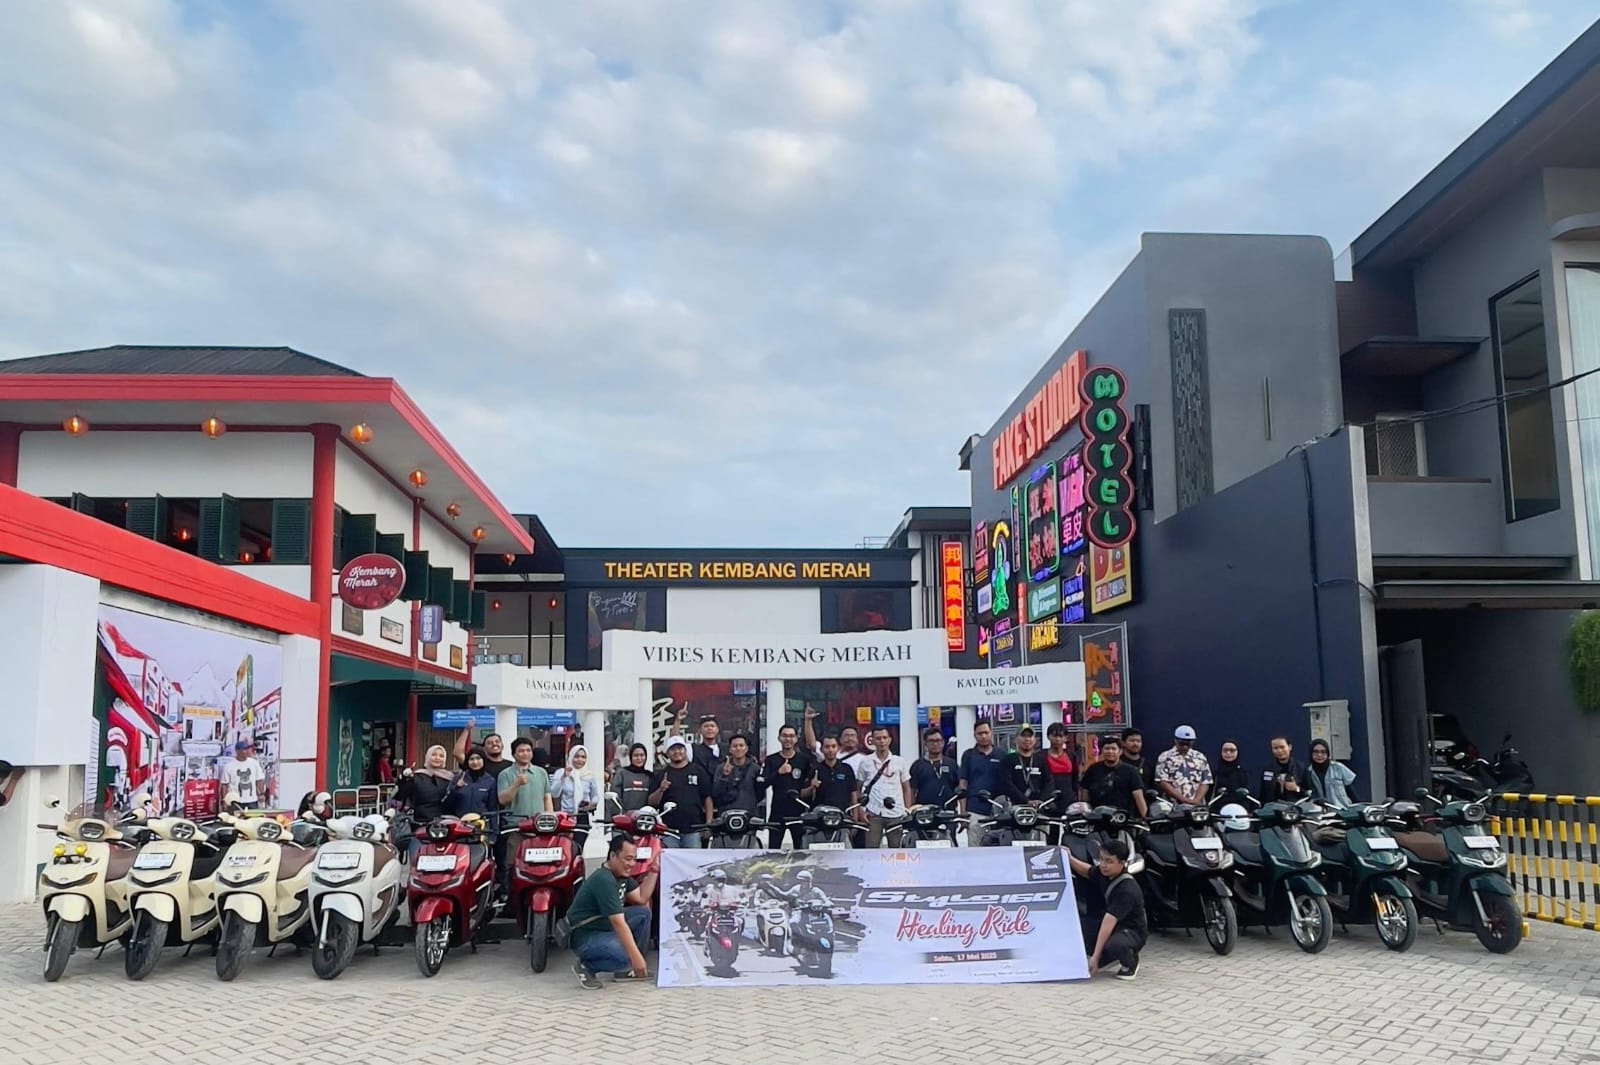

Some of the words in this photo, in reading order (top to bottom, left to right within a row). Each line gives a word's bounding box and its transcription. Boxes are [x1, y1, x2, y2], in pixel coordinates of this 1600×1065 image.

[992, 412, 1025, 490] FAKE
[1025, 350, 1082, 459] STUDIO
[1093, 373, 1120, 537] MOTEL
[349, 566, 398, 579] Kembang
[604, 562, 693, 579] THEATER
[699, 562, 797, 579] KEMBANG
[802, 562, 872, 579] MERAH
[343, 577, 378, 589] Merah
[643, 646, 704, 663] VIBES
[711, 647, 825, 664] KEMBANG
[832, 645, 912, 663] MERAH
[568, 681, 593, 692] JAYA
[957, 677, 1005, 689] KAVLING
[1009, 675, 1039, 686] POLDA
[896, 906, 977, 948] Healing
[979, 904, 1035, 940] Ride
